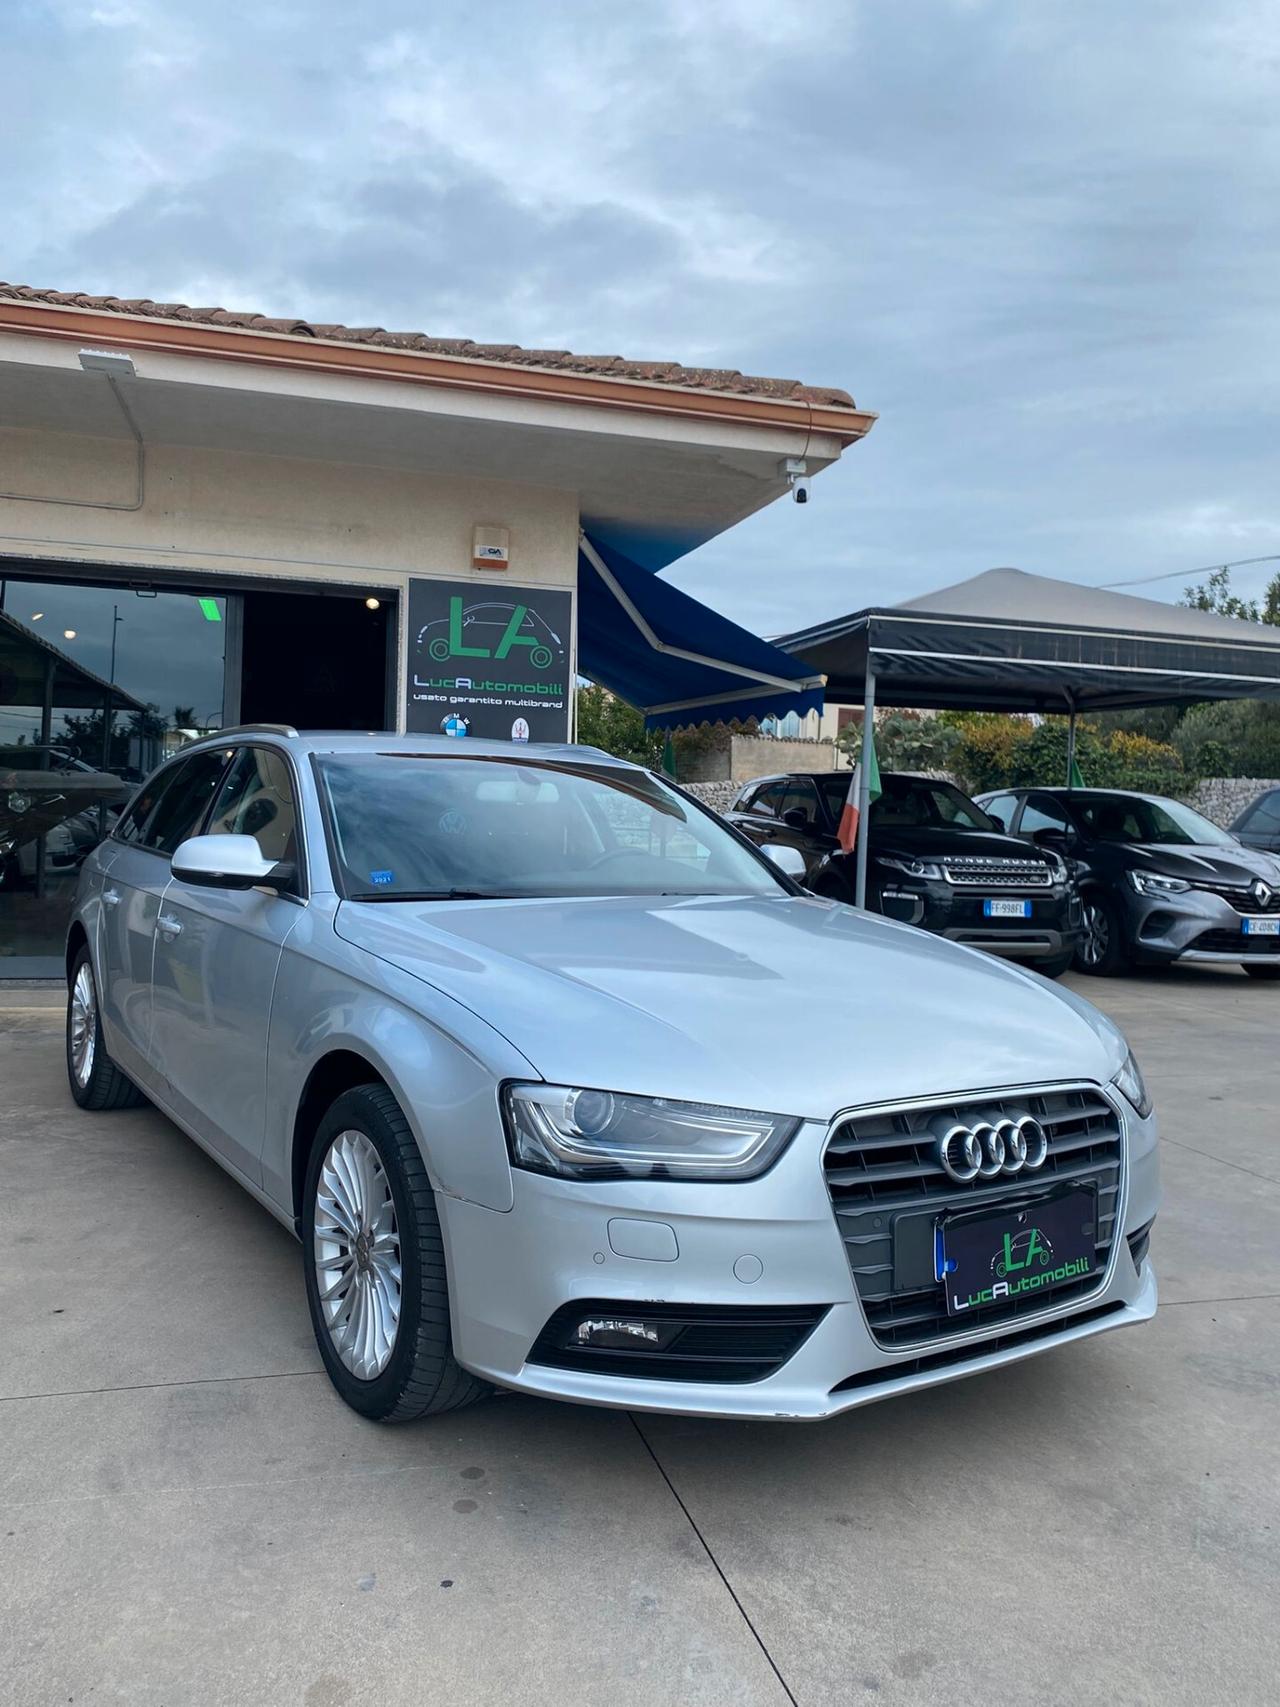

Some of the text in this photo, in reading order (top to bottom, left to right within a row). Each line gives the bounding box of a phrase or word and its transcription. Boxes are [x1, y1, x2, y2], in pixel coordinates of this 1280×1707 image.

[413, 674, 563, 696] LucAutomobili
[413, 693, 563, 709] usato garantito multibrand
[954, 1257, 1090, 1311] LucAutomobili
